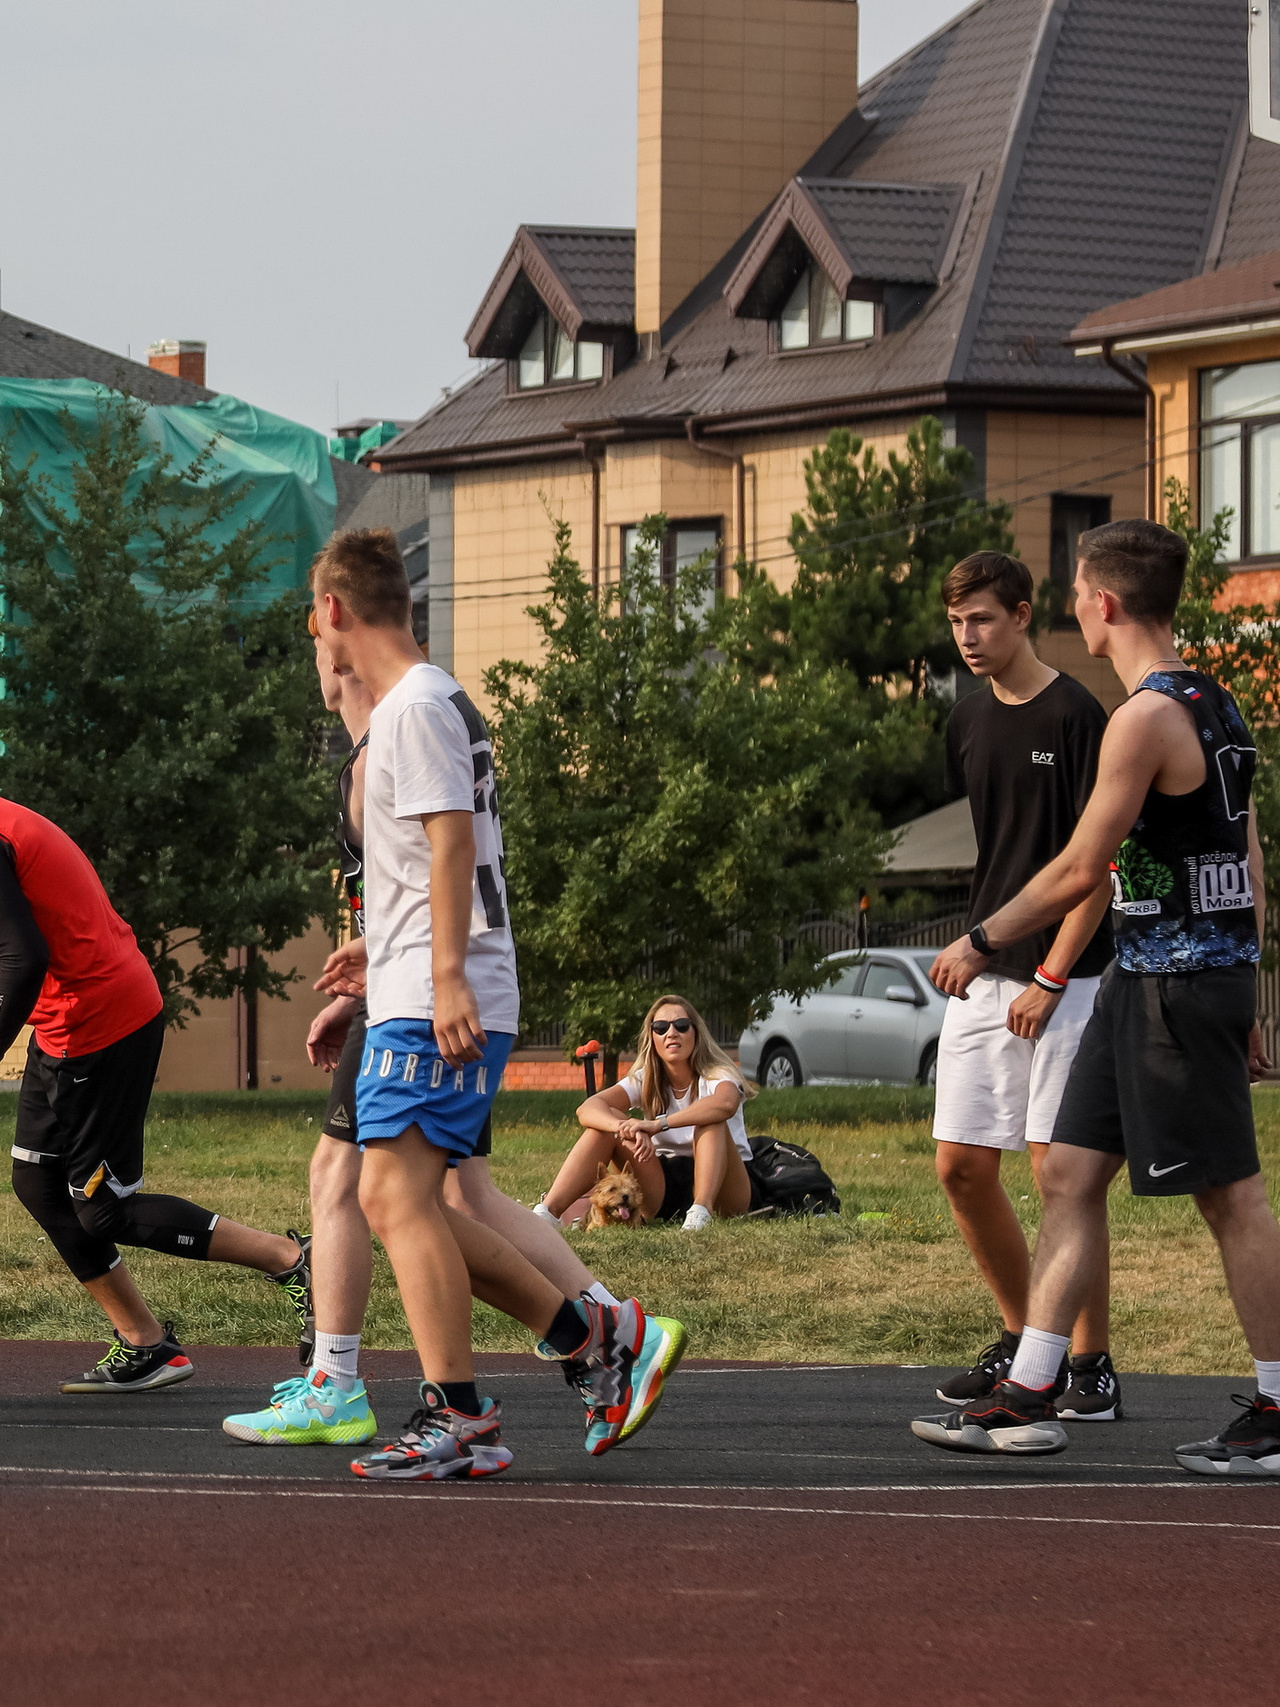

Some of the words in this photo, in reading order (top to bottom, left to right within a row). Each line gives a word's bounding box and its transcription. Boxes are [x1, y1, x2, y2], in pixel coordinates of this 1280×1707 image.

[1032, 751, 1055, 763] EA7
[1207, 897, 1242, 909] Моя
[363, 1048, 488, 1095] JORDAN
